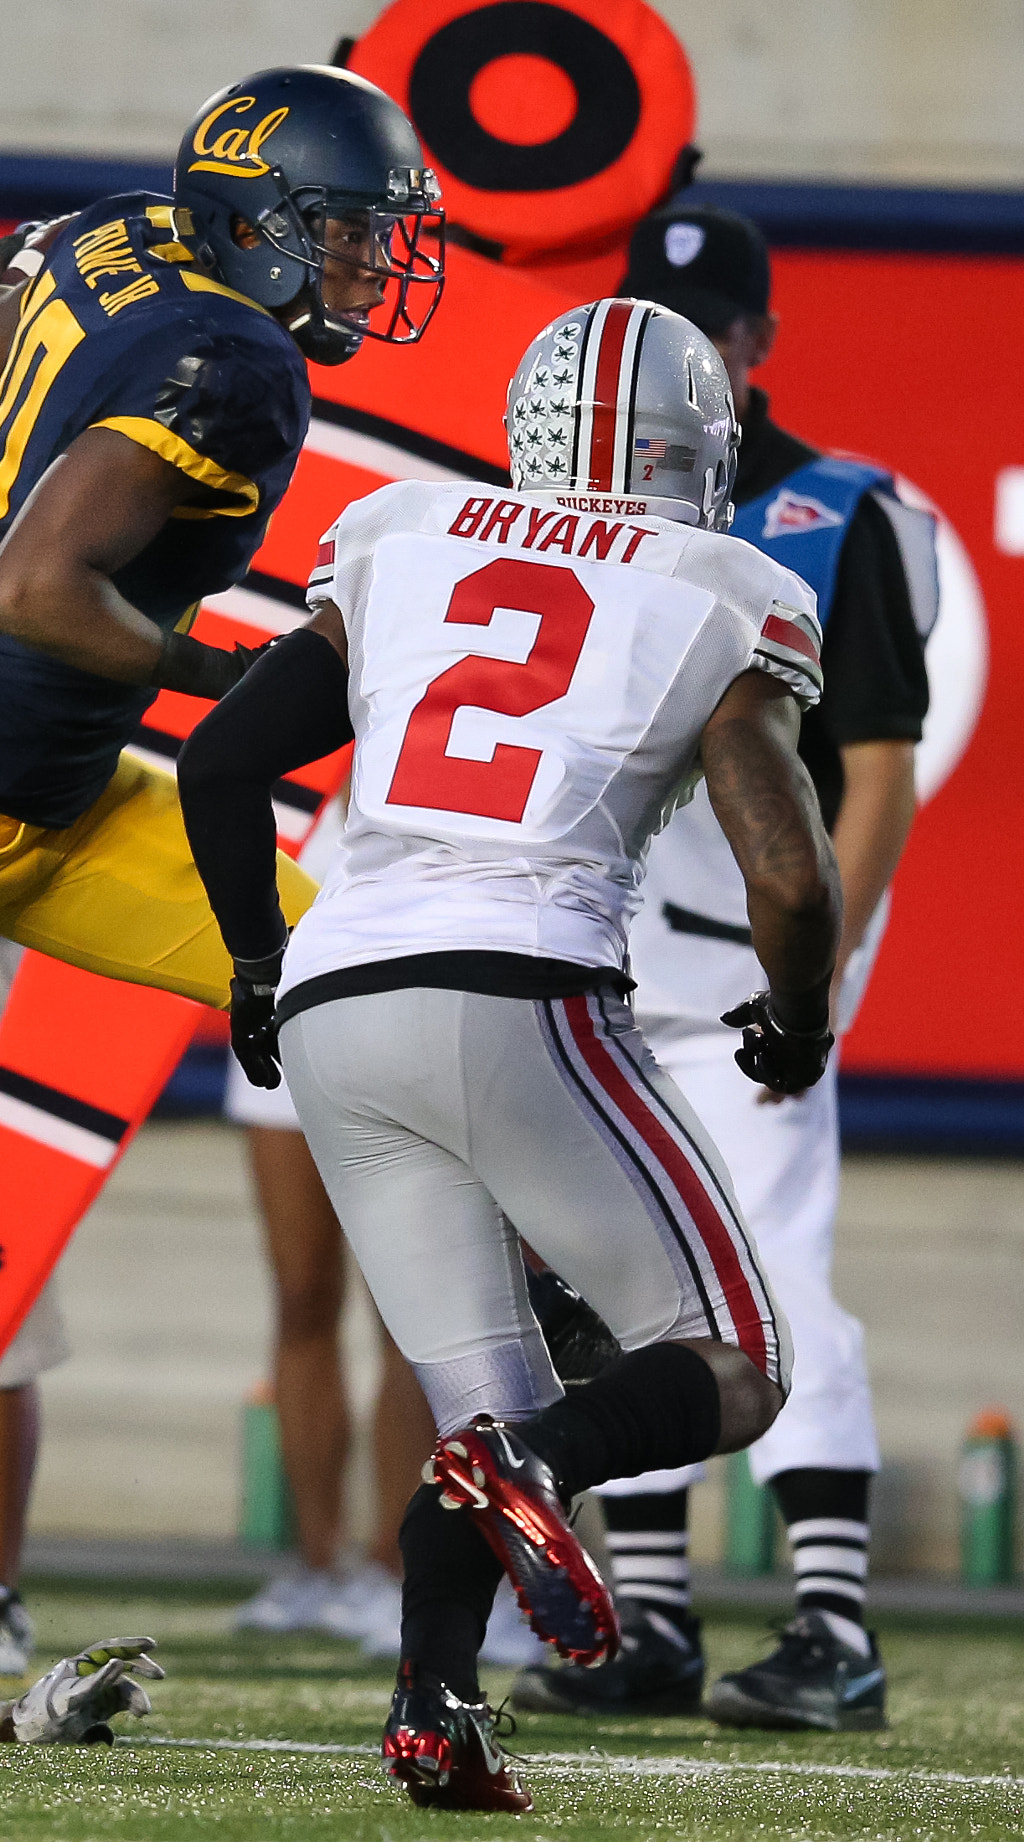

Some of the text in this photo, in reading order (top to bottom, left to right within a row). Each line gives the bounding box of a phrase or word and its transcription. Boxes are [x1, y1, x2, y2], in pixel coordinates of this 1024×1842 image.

[187, 96, 290, 178] Cal
[72, 218, 160, 317] POWE JR
[641, 464, 654, 481] 2
[447, 497, 659, 564] BRYANT
[385, 557, 595, 824] 2
